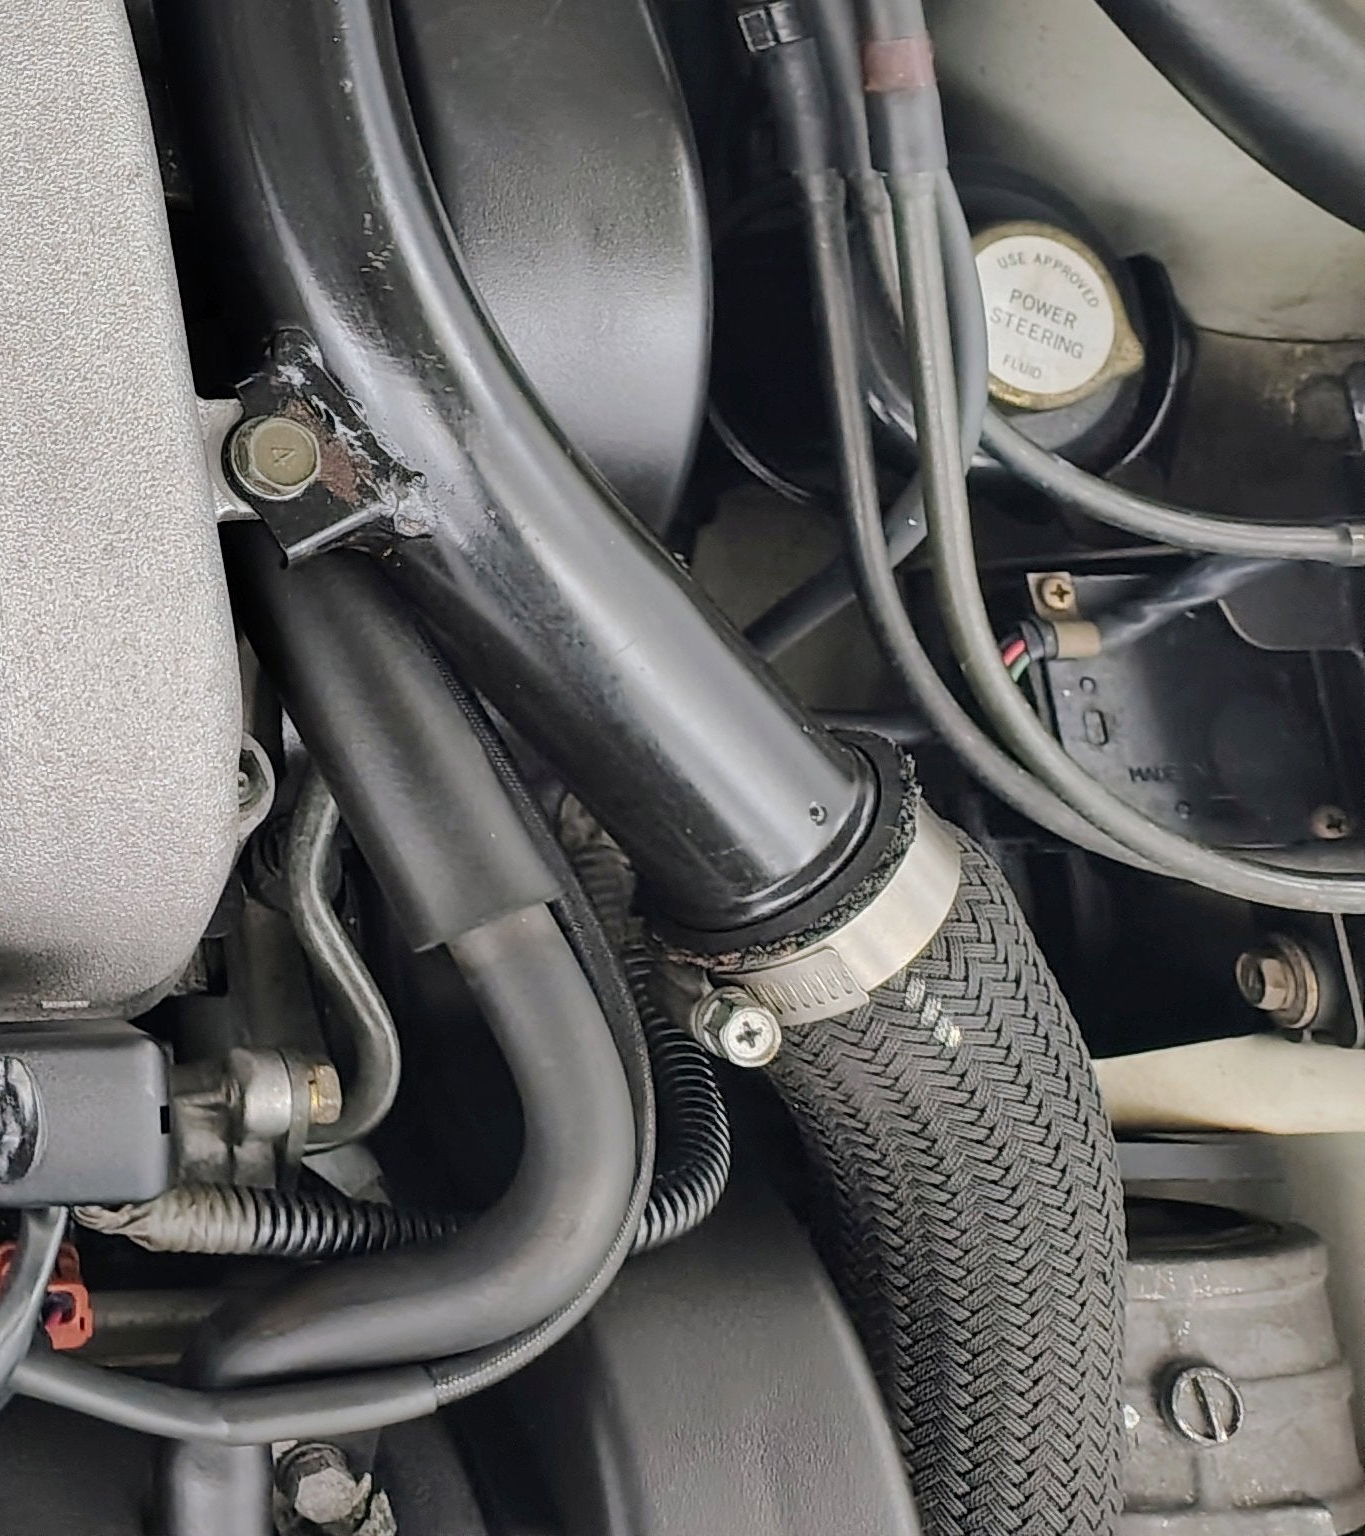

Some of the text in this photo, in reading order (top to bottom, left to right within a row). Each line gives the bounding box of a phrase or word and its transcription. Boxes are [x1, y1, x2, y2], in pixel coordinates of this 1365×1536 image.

[996, 251, 1100, 308] USE APPROVED
[1009, 288, 1078, 330] POWER
[989, 307, 1084, 360] STEERING
[1002, 354, 1043, 380] FLUID
